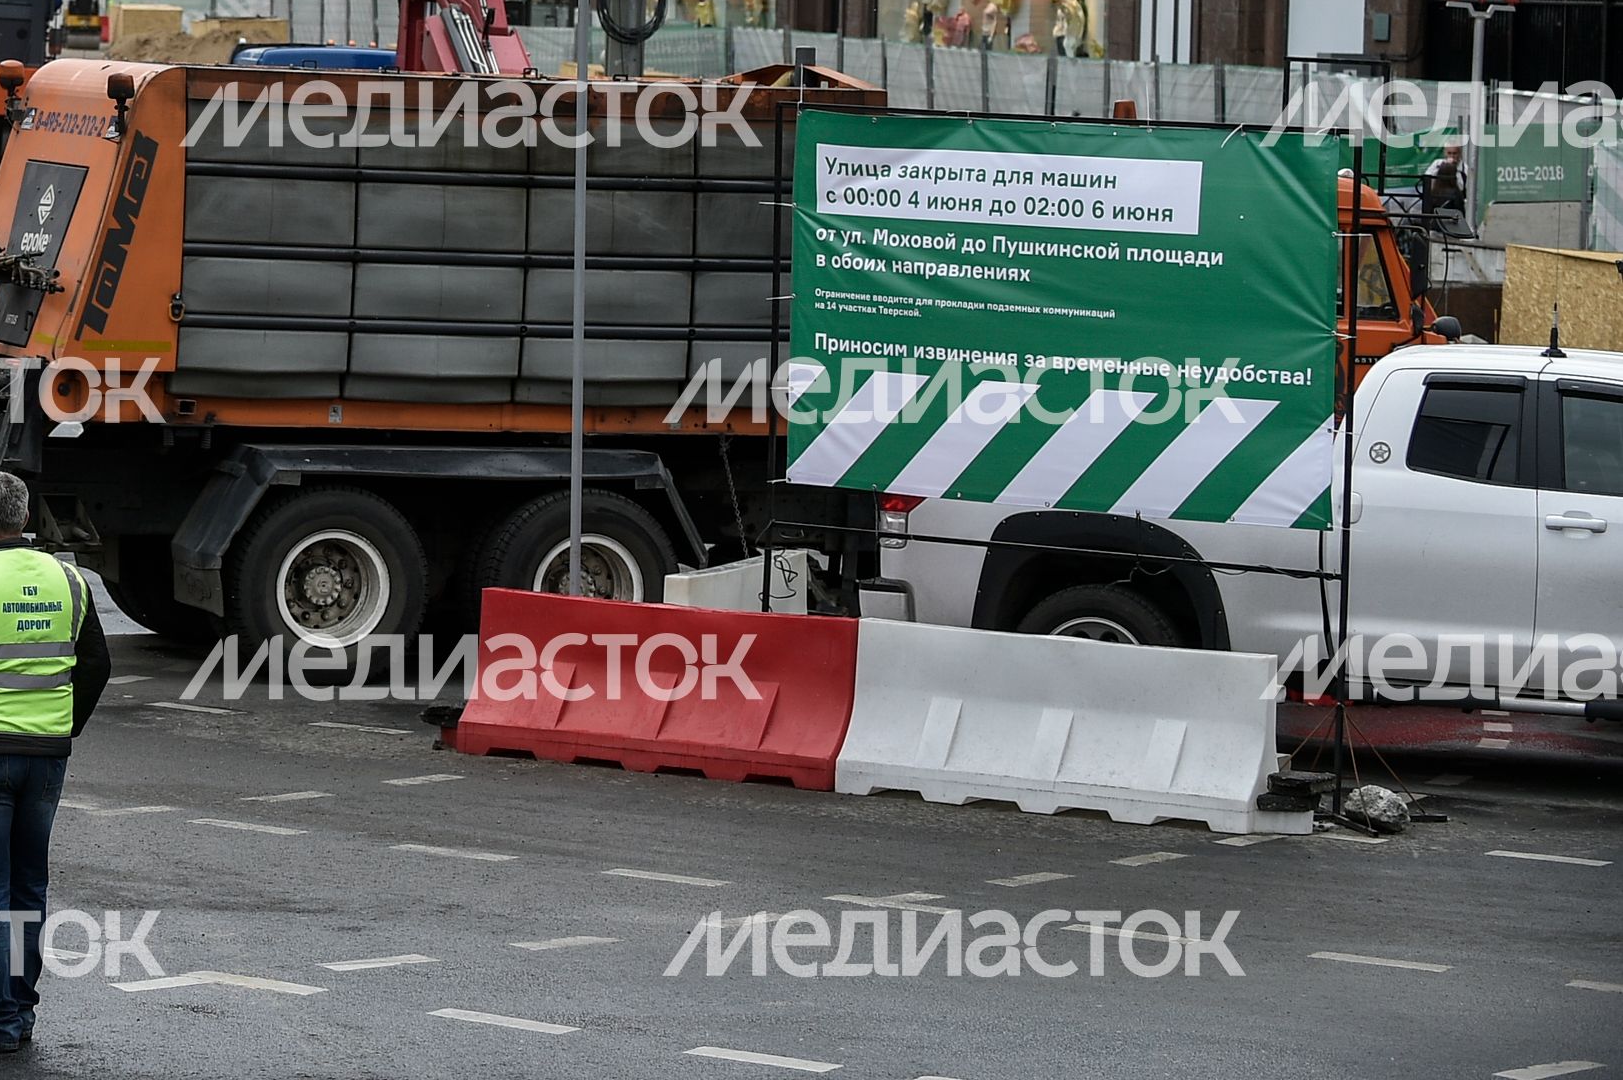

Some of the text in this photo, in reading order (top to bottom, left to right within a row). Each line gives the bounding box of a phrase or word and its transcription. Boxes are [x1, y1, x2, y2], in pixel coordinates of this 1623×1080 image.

[825, 157, 1116, 189] Улица закрыта для машин
[826, 187, 1172, 222] с 00:00 4 июня до 02:00 6 июня
[816, 228, 1222, 267] от ул. Моховой до Пушкинской площади
[817, 252, 1030, 281] в обоих направлениях
[815, 288, 1115, 318] Ограничение вводится для прокладки подземных коммуникаций
[839, 304, 876, 313] участках
[878, 306, 921, 317] Тверской.
[816, 333, 1312, 386] Приносим извинения за временные неудобства!
[22, 586, 38, 597] ГБУ
[2, 601, 63, 613] АВТОМОБИЛЬНЫЕ
[16, 619, 51, 632] ДОРОГИ
